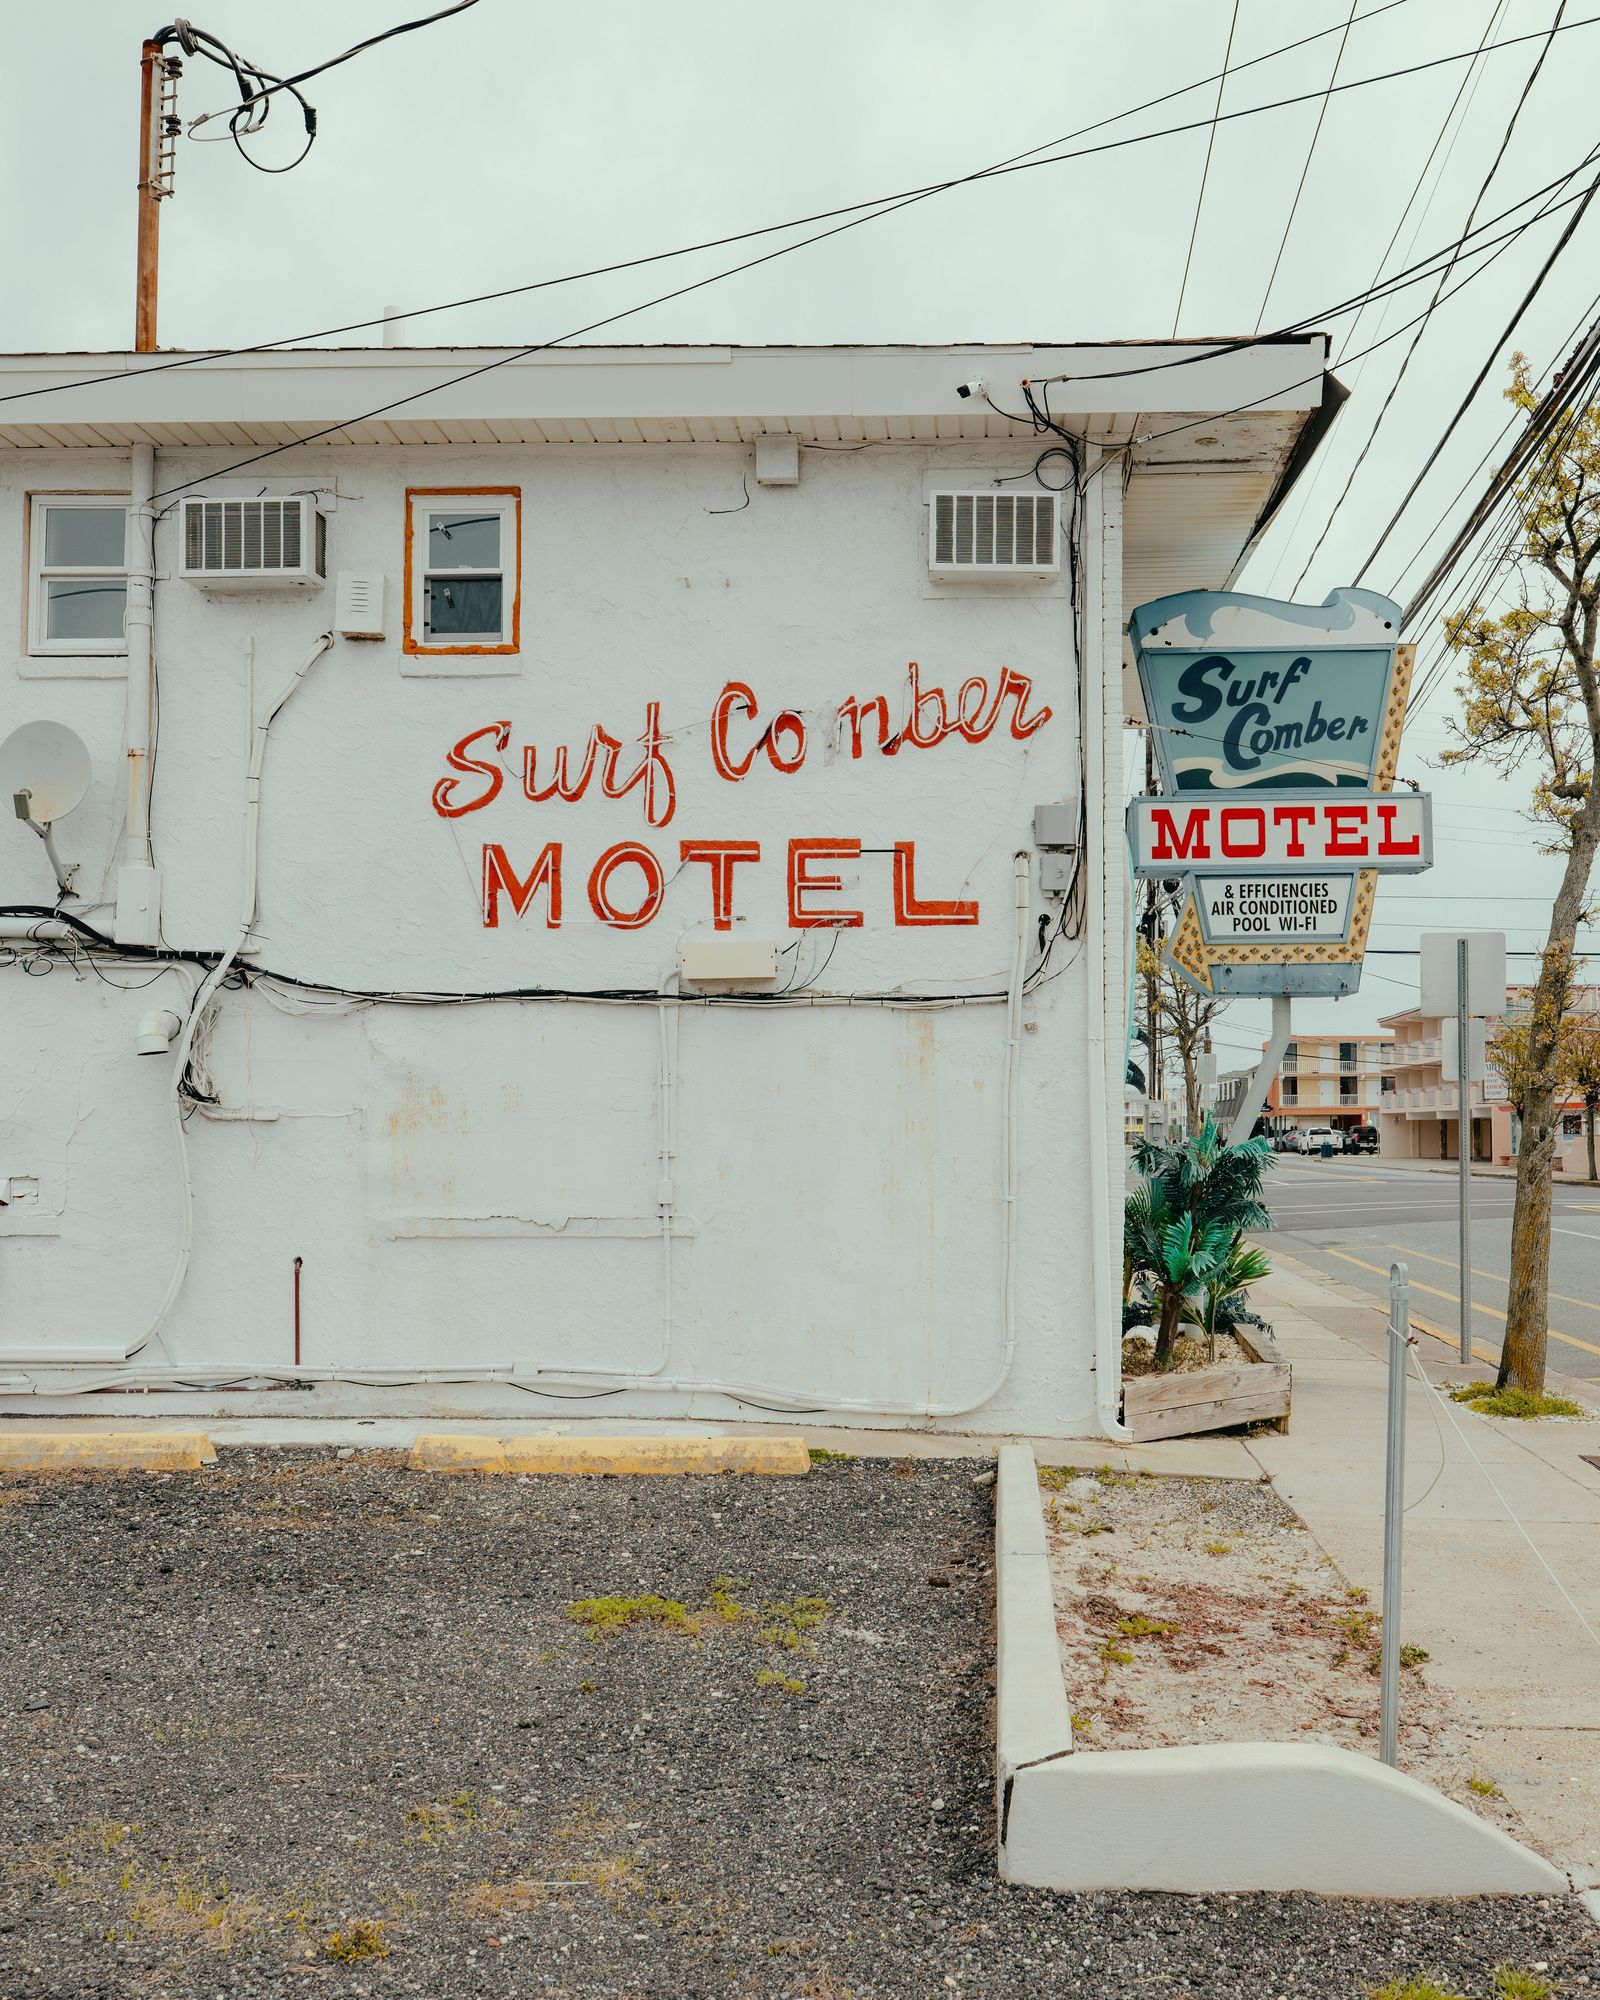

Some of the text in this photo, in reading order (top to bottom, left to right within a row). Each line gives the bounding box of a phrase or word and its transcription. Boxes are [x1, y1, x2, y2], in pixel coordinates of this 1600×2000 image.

[1171, 655, 1313, 723] Surf
[432, 701, 676, 829] Surf
[1222, 700, 1369, 771] Comber
[1151, 805, 1420, 860] MOTEL
[482, 838, 979, 931] MOTEL
[1211, 899, 1338, 916] AIR CONDITIONED
[1224, 883, 1329, 899] & EFFICIENCIES
[1232, 916, 1317, 932] POOL WI-FI
